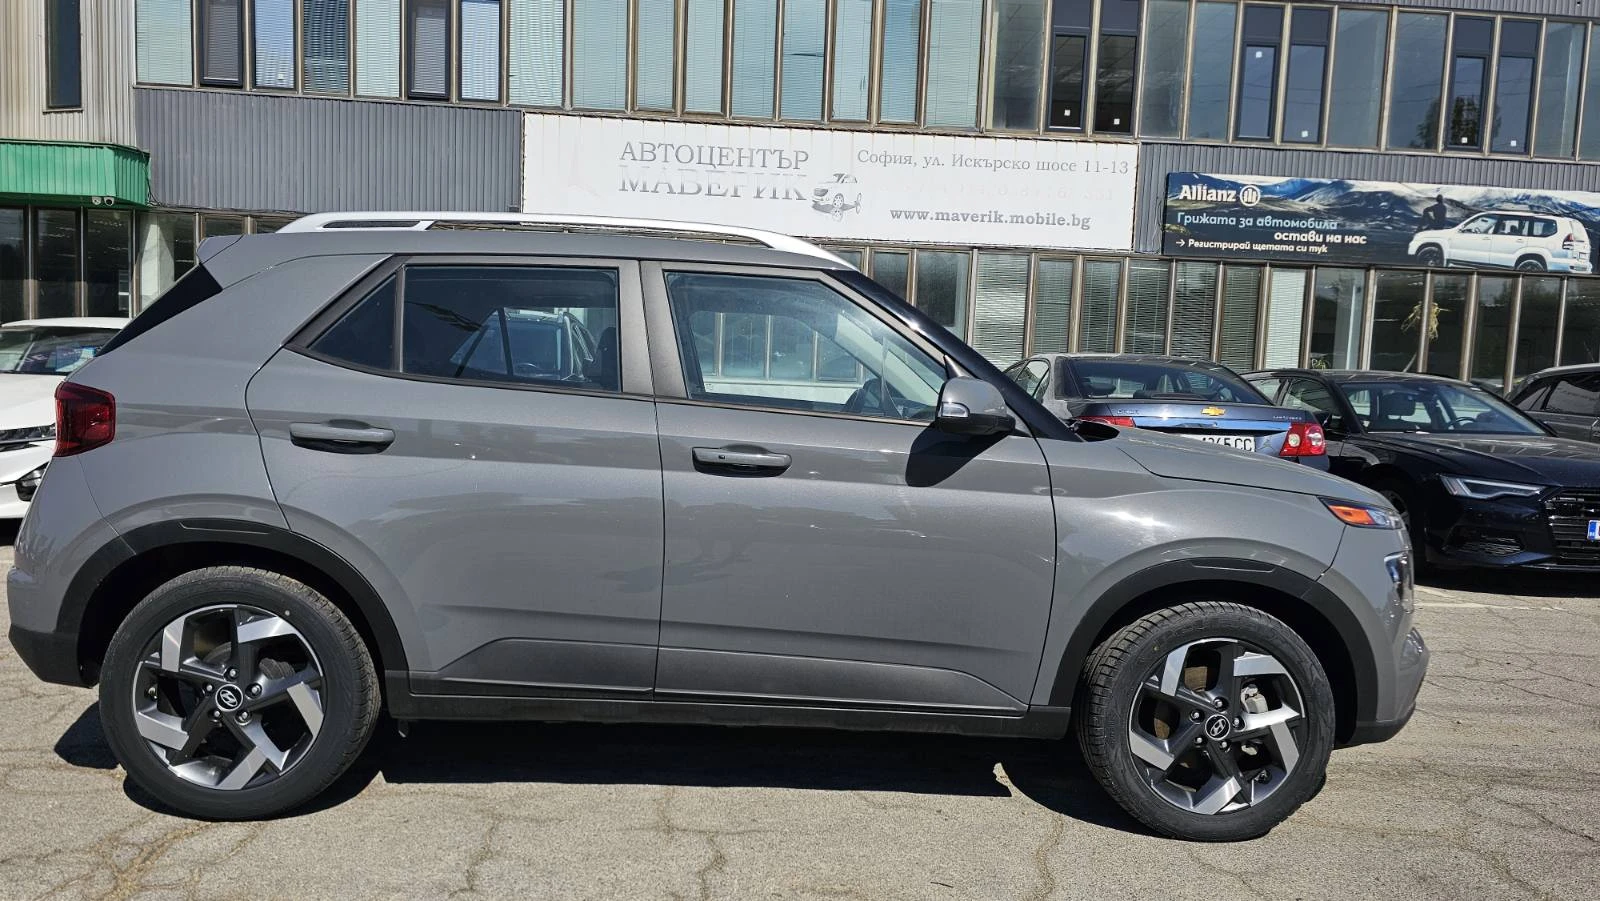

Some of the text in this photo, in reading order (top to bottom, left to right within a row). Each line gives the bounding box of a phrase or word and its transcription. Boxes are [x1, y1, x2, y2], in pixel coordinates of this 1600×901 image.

[620, 141, 809, 170] АВТОЦЕНТЪР
[857, 149, 917, 168] София,
[922, 154, 945, 168] ул.
[951, 154, 1031, 172] Искърско
[1083, 161, 1129, 174] 11-13
[1179, 184, 1237, 202] Allianz
[890, 209, 1092, 230] www.maverik.mobile.bg
[1177, 212, 1338, 229] Грижата за автомобила
[1274, 230, 1368, 244] остави на нас
[1188, 239, 1251, 250] Регистрирай
[1252, 243, 1295, 252] щетата
[1310, 244, 1328, 254] тук
